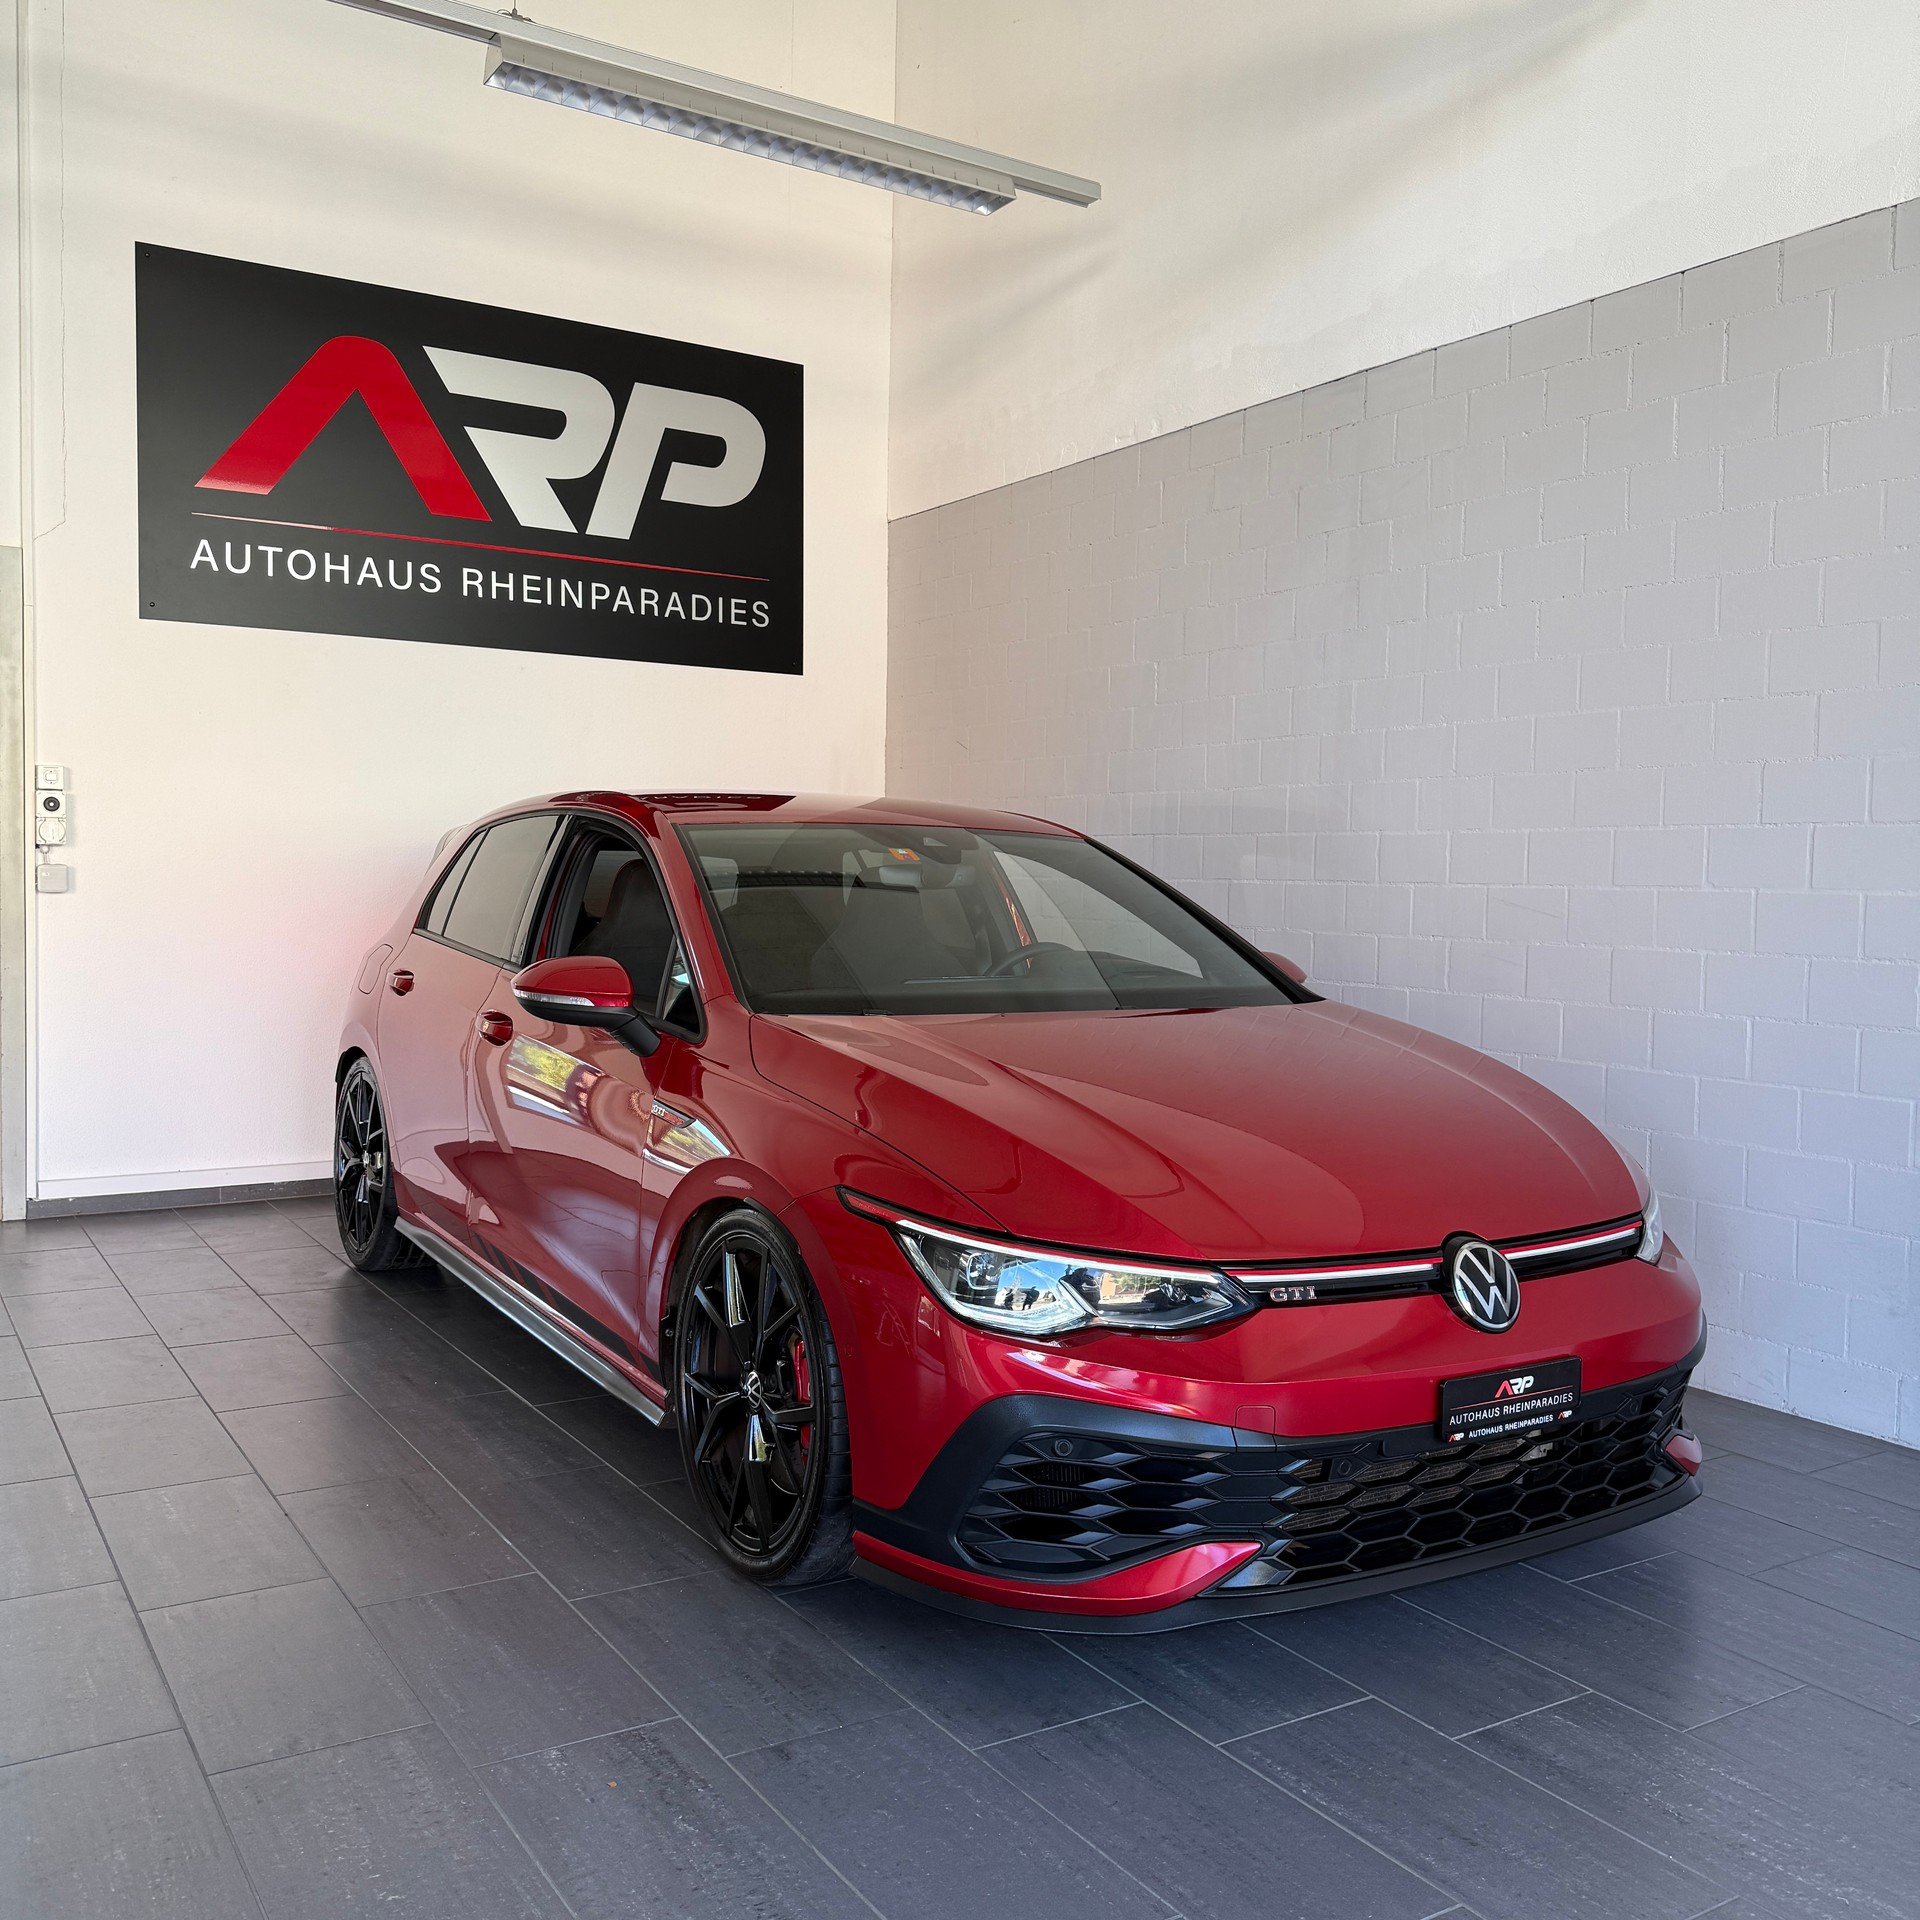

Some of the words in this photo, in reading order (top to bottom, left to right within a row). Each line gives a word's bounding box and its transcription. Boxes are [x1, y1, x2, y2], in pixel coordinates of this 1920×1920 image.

[194, 336, 765, 539] ARP
[190, 539, 442, 594] AUTOHAUS
[463, 568, 770, 628] RHEINPARADIES
[1269, 1286, 1317, 1302] GTI
[1495, 1375, 1534, 1398] ARP
[1449, 1407, 1500, 1426] AUTOHAUS
[1503, 1392, 1573, 1415] RHEINPARADIES
[1468, 1425, 1503, 1438] AUTOHAUS
[1504, 1414, 1553, 1430] RHEINPARADIES
